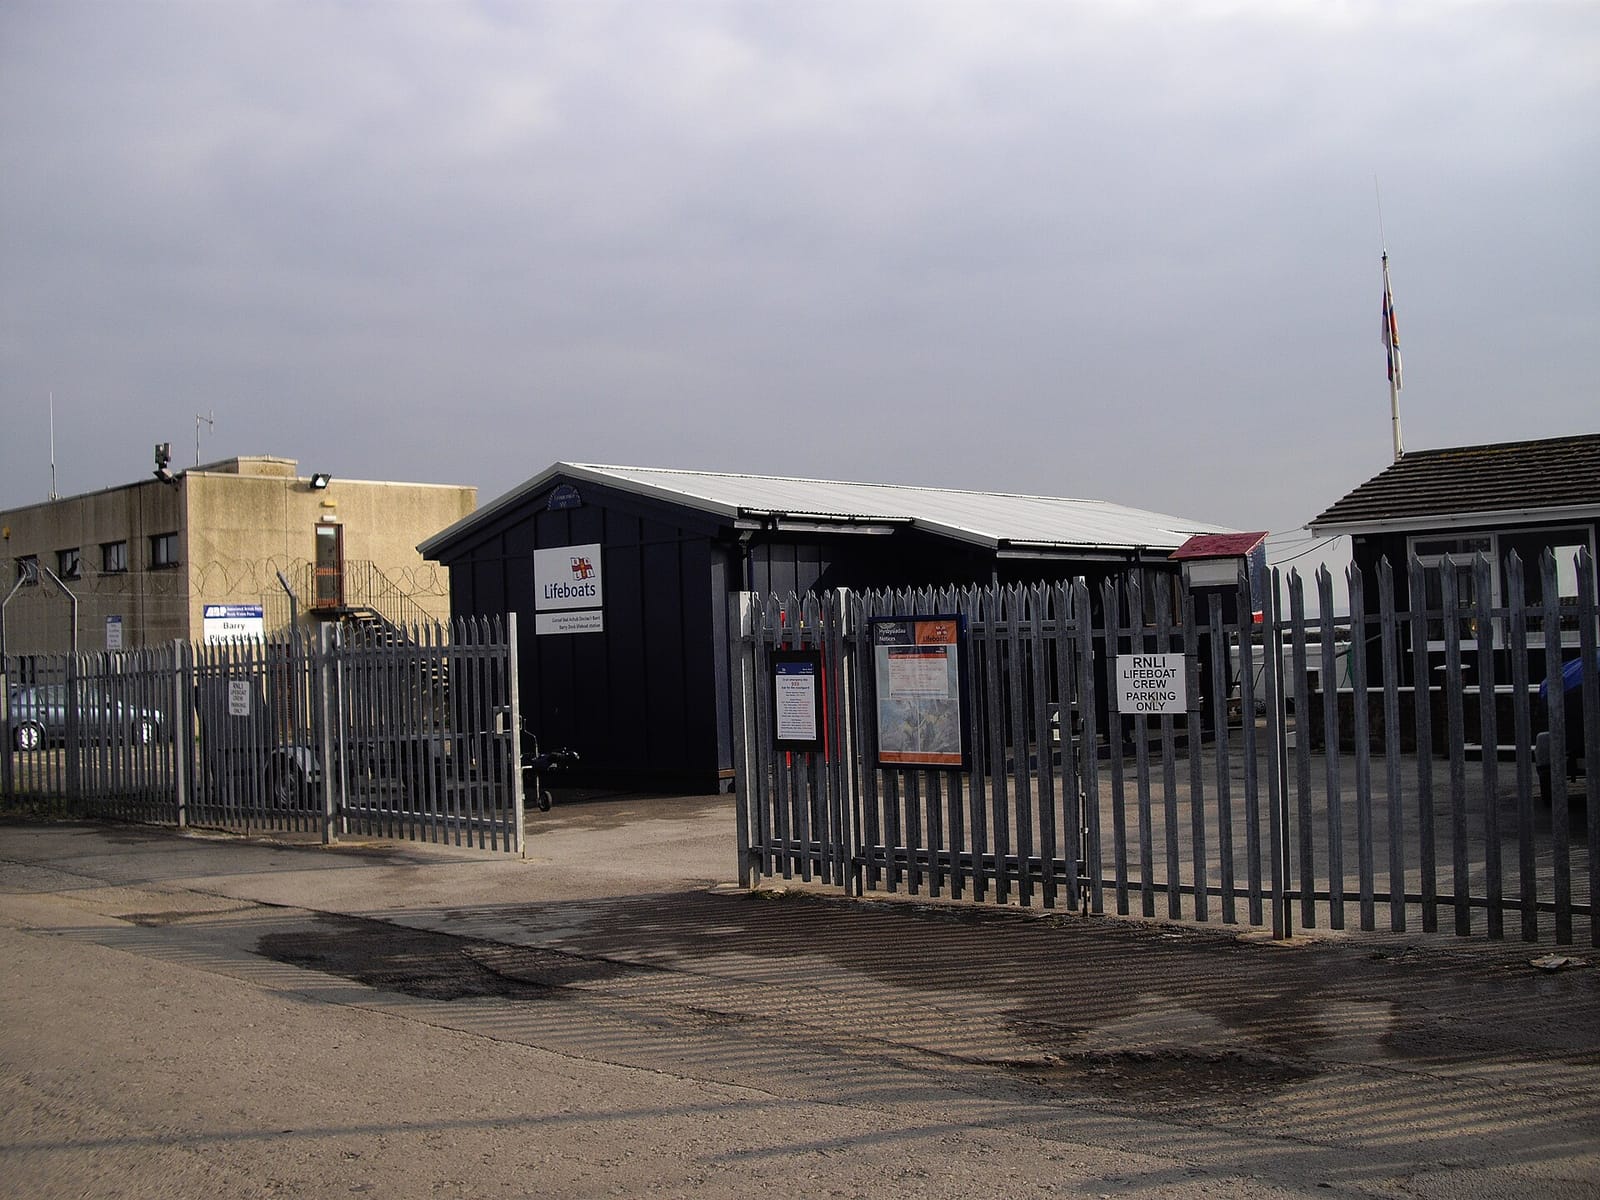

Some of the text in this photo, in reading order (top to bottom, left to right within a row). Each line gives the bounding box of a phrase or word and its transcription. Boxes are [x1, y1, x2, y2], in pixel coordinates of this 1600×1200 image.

[544, 582, 596, 599] Lifeboats
[223, 622, 246, 631] Barry
[1133, 656, 1166, 668] RNLI
[1123, 668, 1177, 679] LIFEBOAT
[1133, 679, 1167, 689] CREW
[1126, 691, 1176, 701] PARKING
[1136, 701, 1166, 711] ONLY
